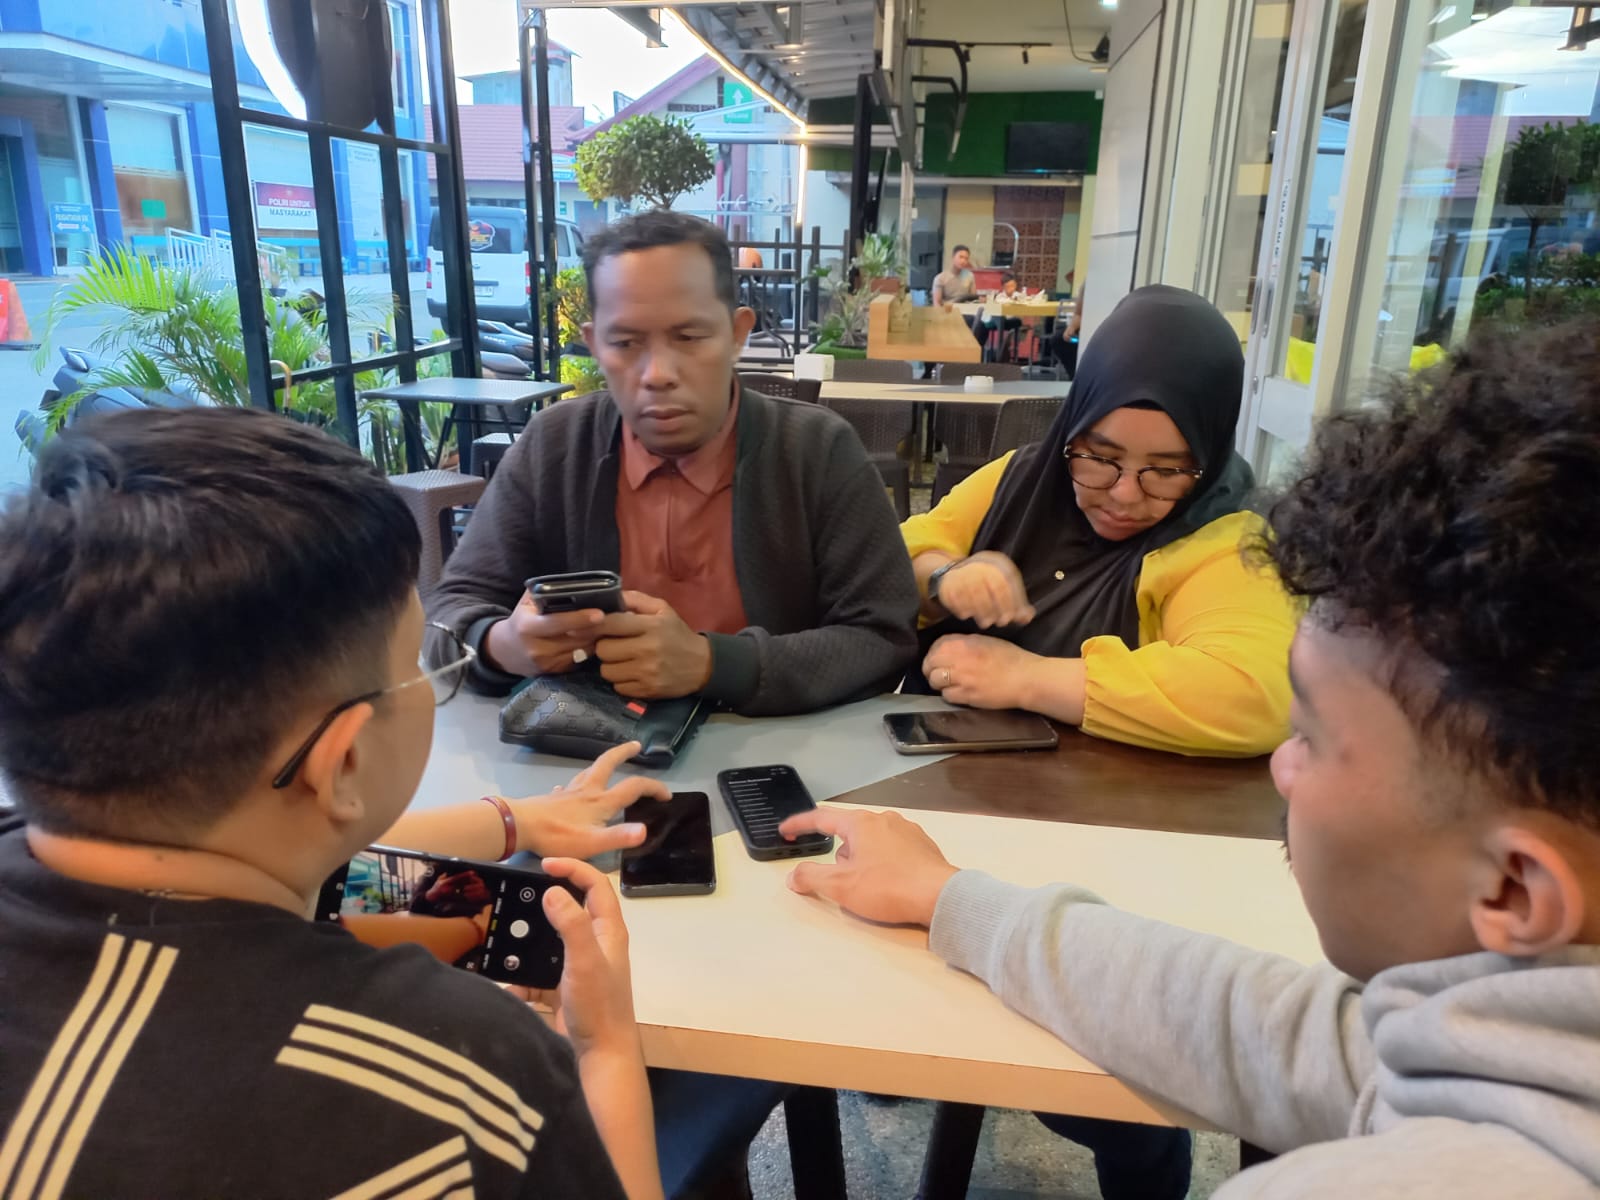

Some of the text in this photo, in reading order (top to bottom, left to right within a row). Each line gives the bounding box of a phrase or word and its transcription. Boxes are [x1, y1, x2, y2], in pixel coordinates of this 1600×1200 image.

[268, 198, 311, 208] POLRI UNTUK
[269, 208, 311, 217] MASYARAKAT
